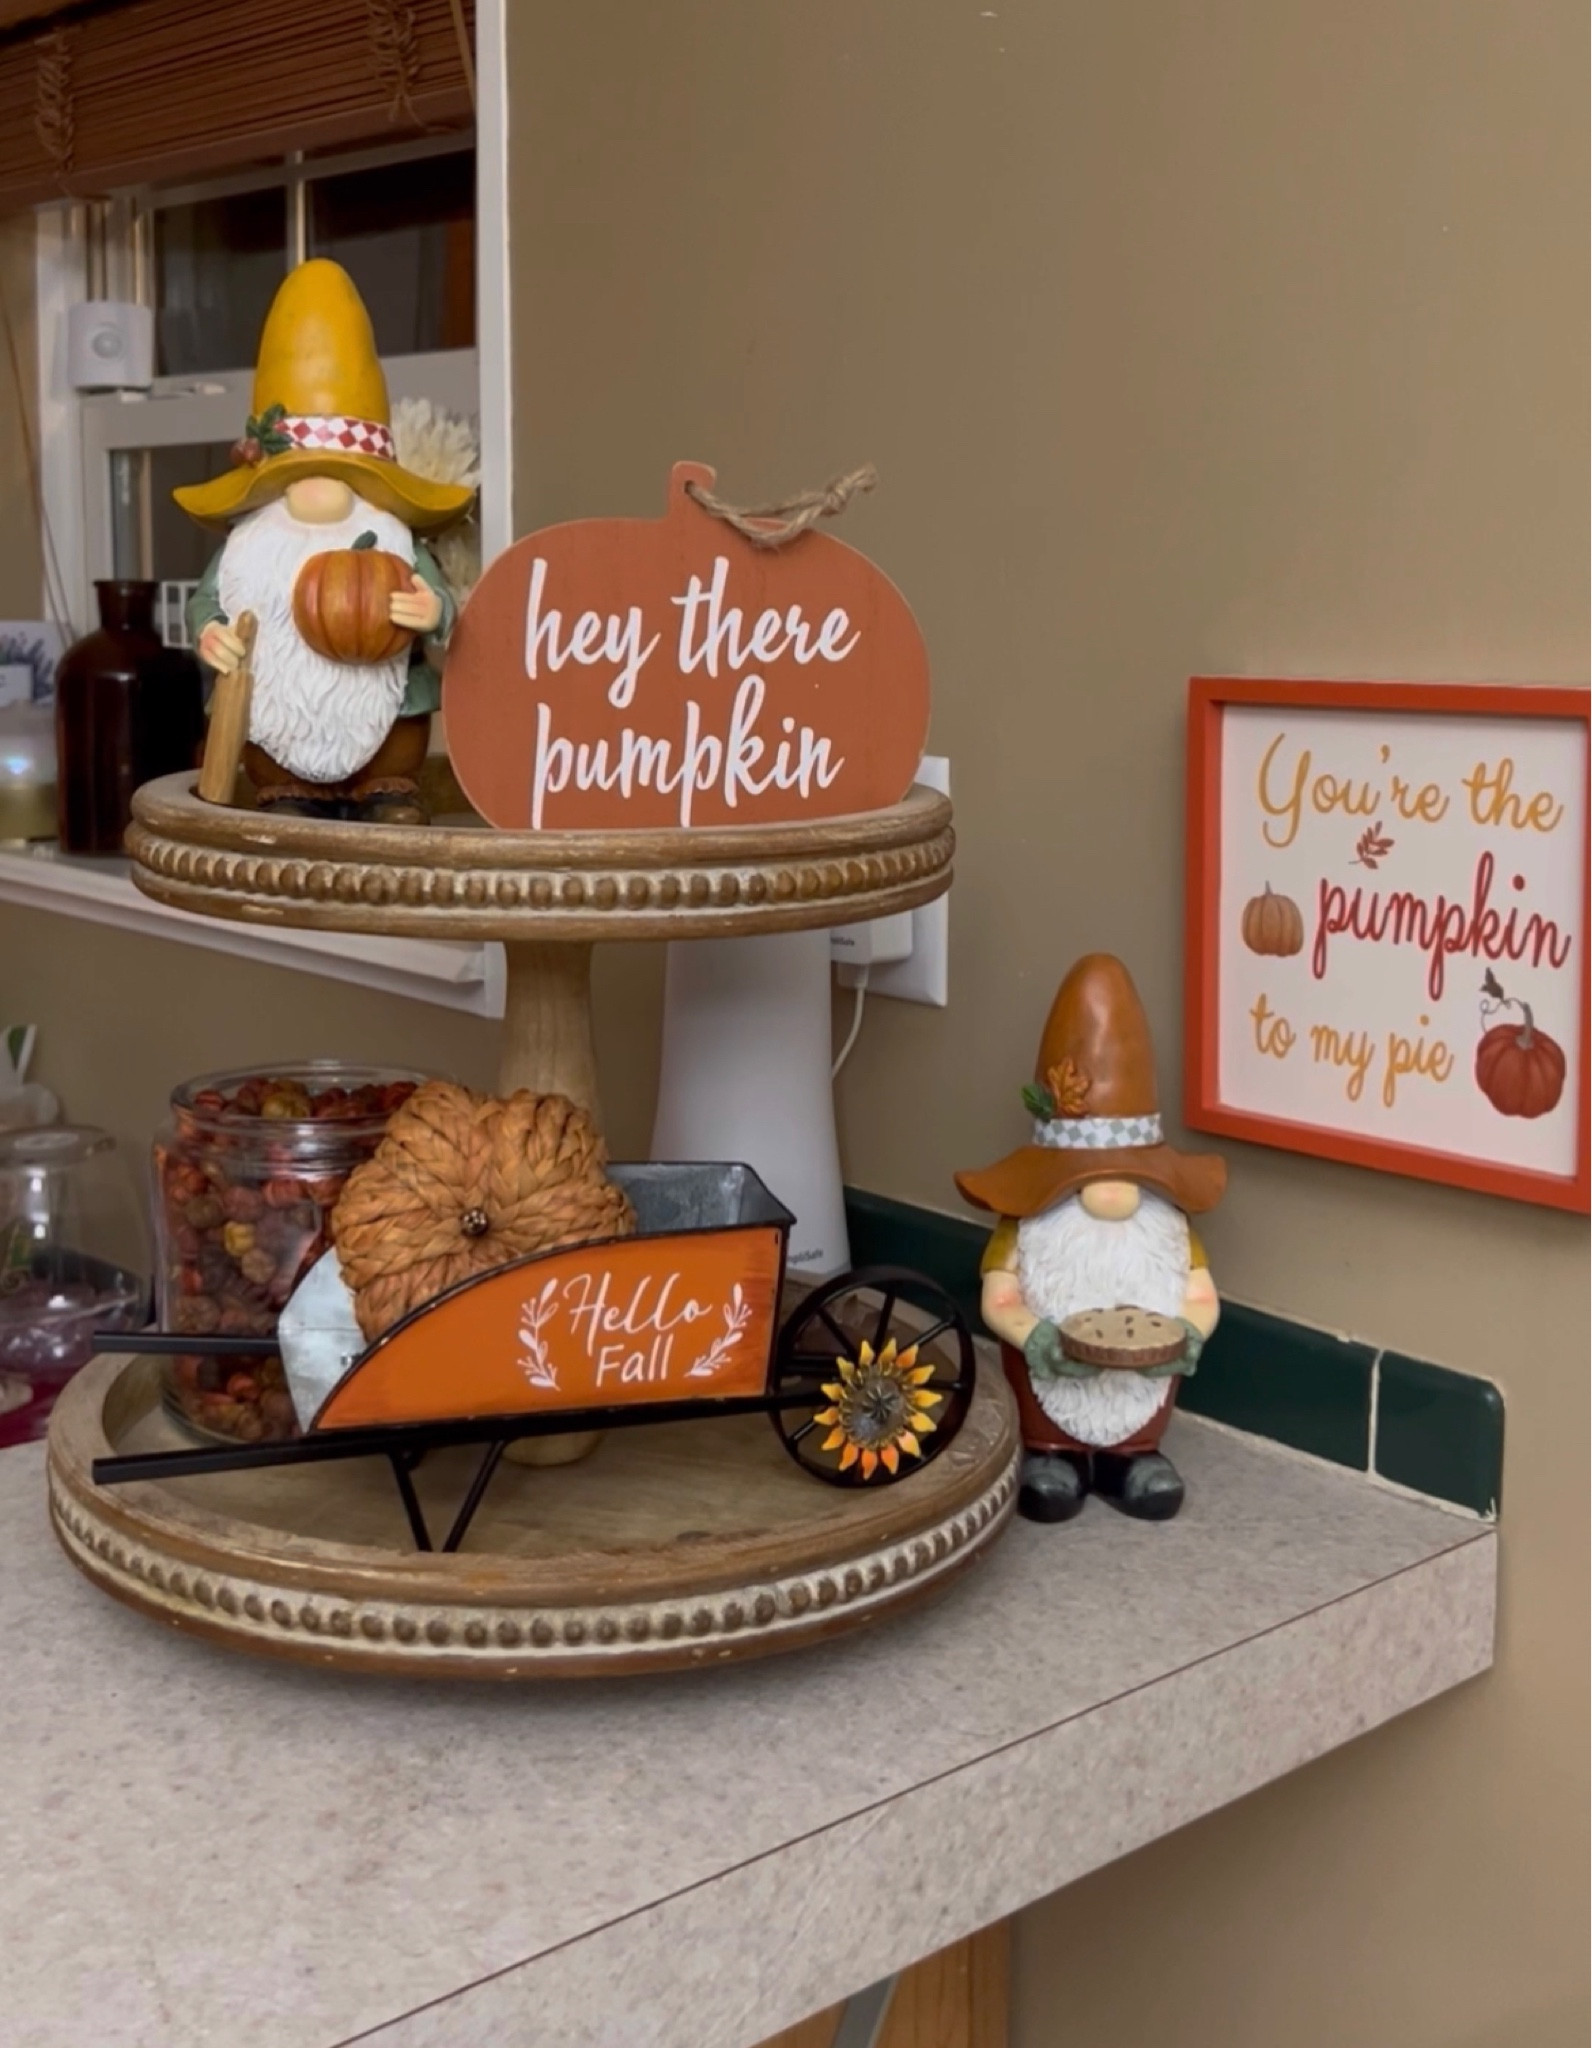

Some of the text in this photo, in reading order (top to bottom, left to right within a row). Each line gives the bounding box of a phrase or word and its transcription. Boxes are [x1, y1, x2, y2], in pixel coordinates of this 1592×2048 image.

[525, 556, 861, 708] hey there
[530, 674, 844, 830] pumpkin
[1258, 732, 1564, 848] You're the
[1313, 851, 1571, 1000] pumpkin
[1250, 993, 1454, 1108] to my pie
[563, 1271, 713, 1357] Hello
[596, 1333, 674, 1388] Fall
